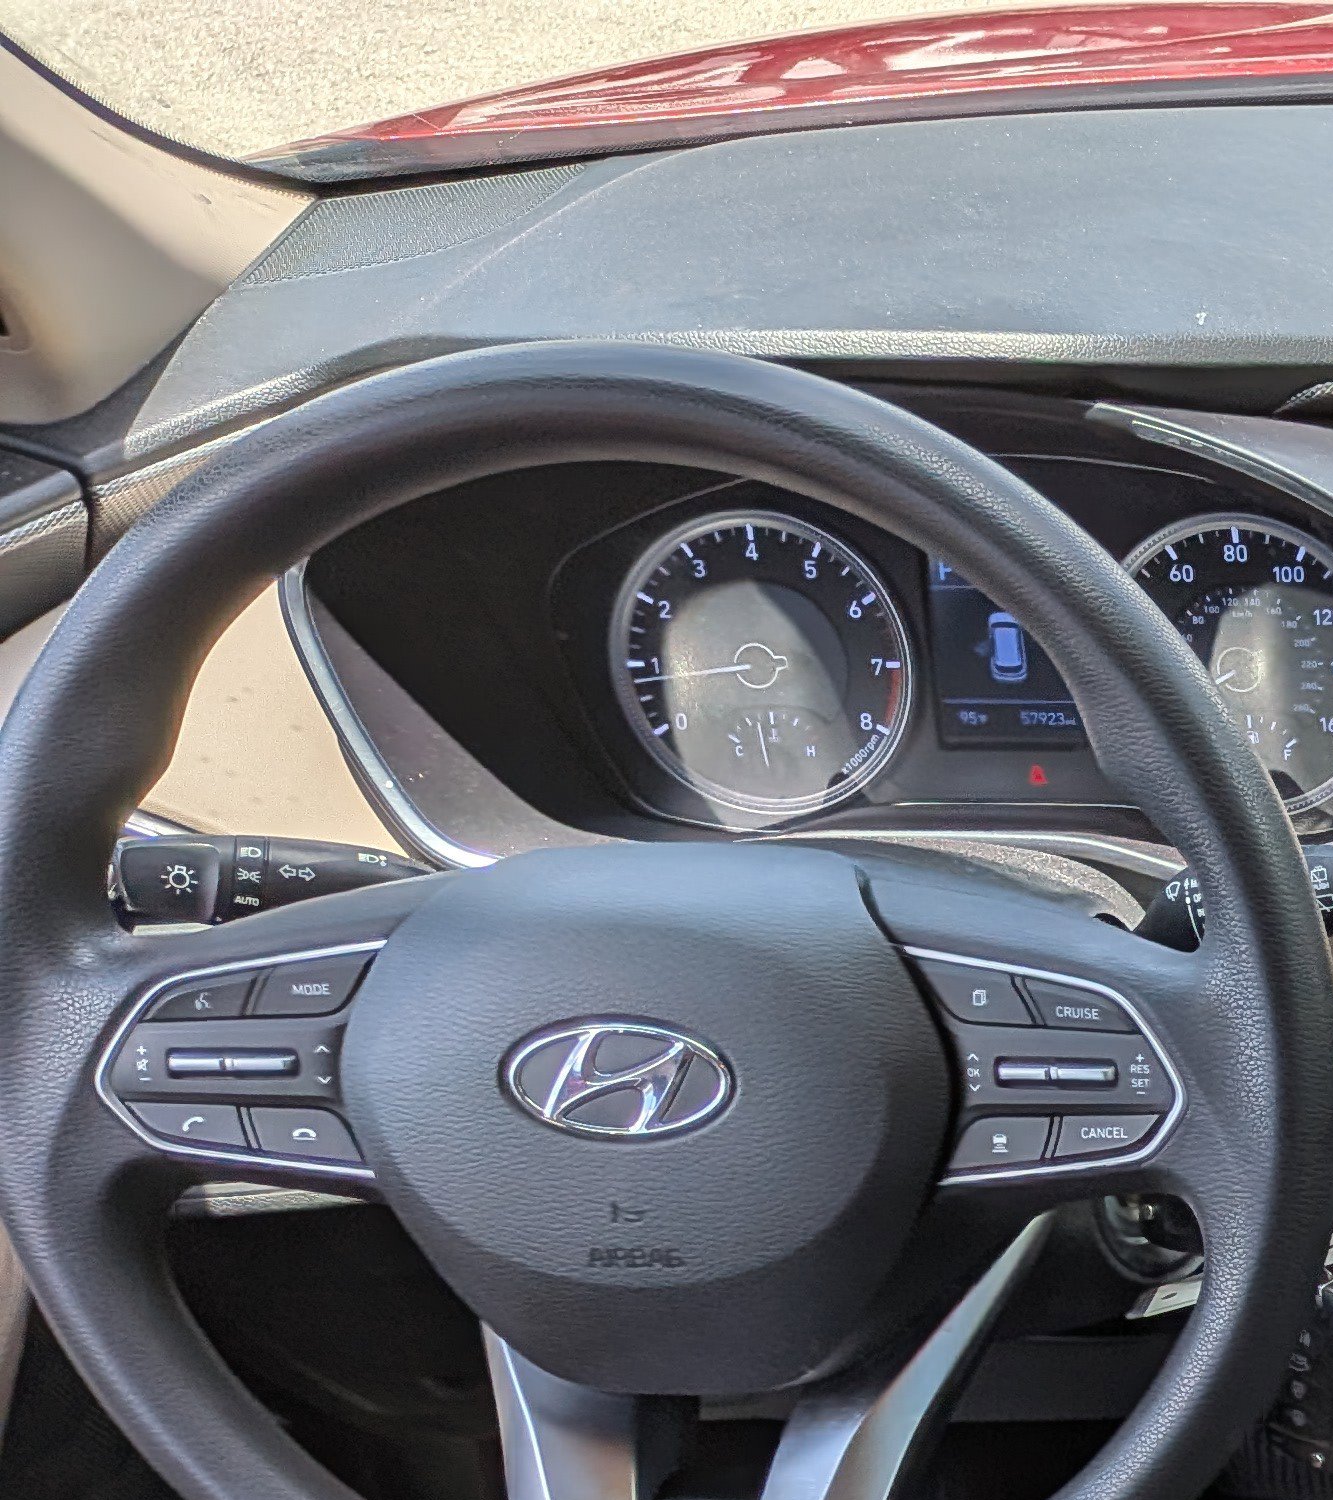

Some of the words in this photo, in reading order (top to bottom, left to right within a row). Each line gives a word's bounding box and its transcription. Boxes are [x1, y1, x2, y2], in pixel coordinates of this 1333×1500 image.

[745, 544, 759, 561] 4
[1223, 545, 1248, 564] 80
[693, 560, 706, 578] 3
[804, 560, 817, 579] 5
[1169, 564, 1194, 583] 60
[1272, 565, 1305, 583] 100
[658, 601, 672, 619] 2
[849, 600, 862, 618] 6
[650, 657, 660, 674] 1
[870, 658, 883, 676] 7
[675, 713, 688, 730] 0
[860, 713, 873, 730] 8
[806, 745, 816, 757] H
[1283, 749, 1294, 761] F
[234, 896, 260, 907] AUTO
[292, 983, 331, 996] MODE
[1055, 1006, 1100, 1020] CRUISE
[966, 1067, 981, 1078] OK
[1130, 1063, 1150, 1075] RES
[1131, 1078, 1150, 1089] SET
[1081, 1126, 1128, 1140] CANCEL
